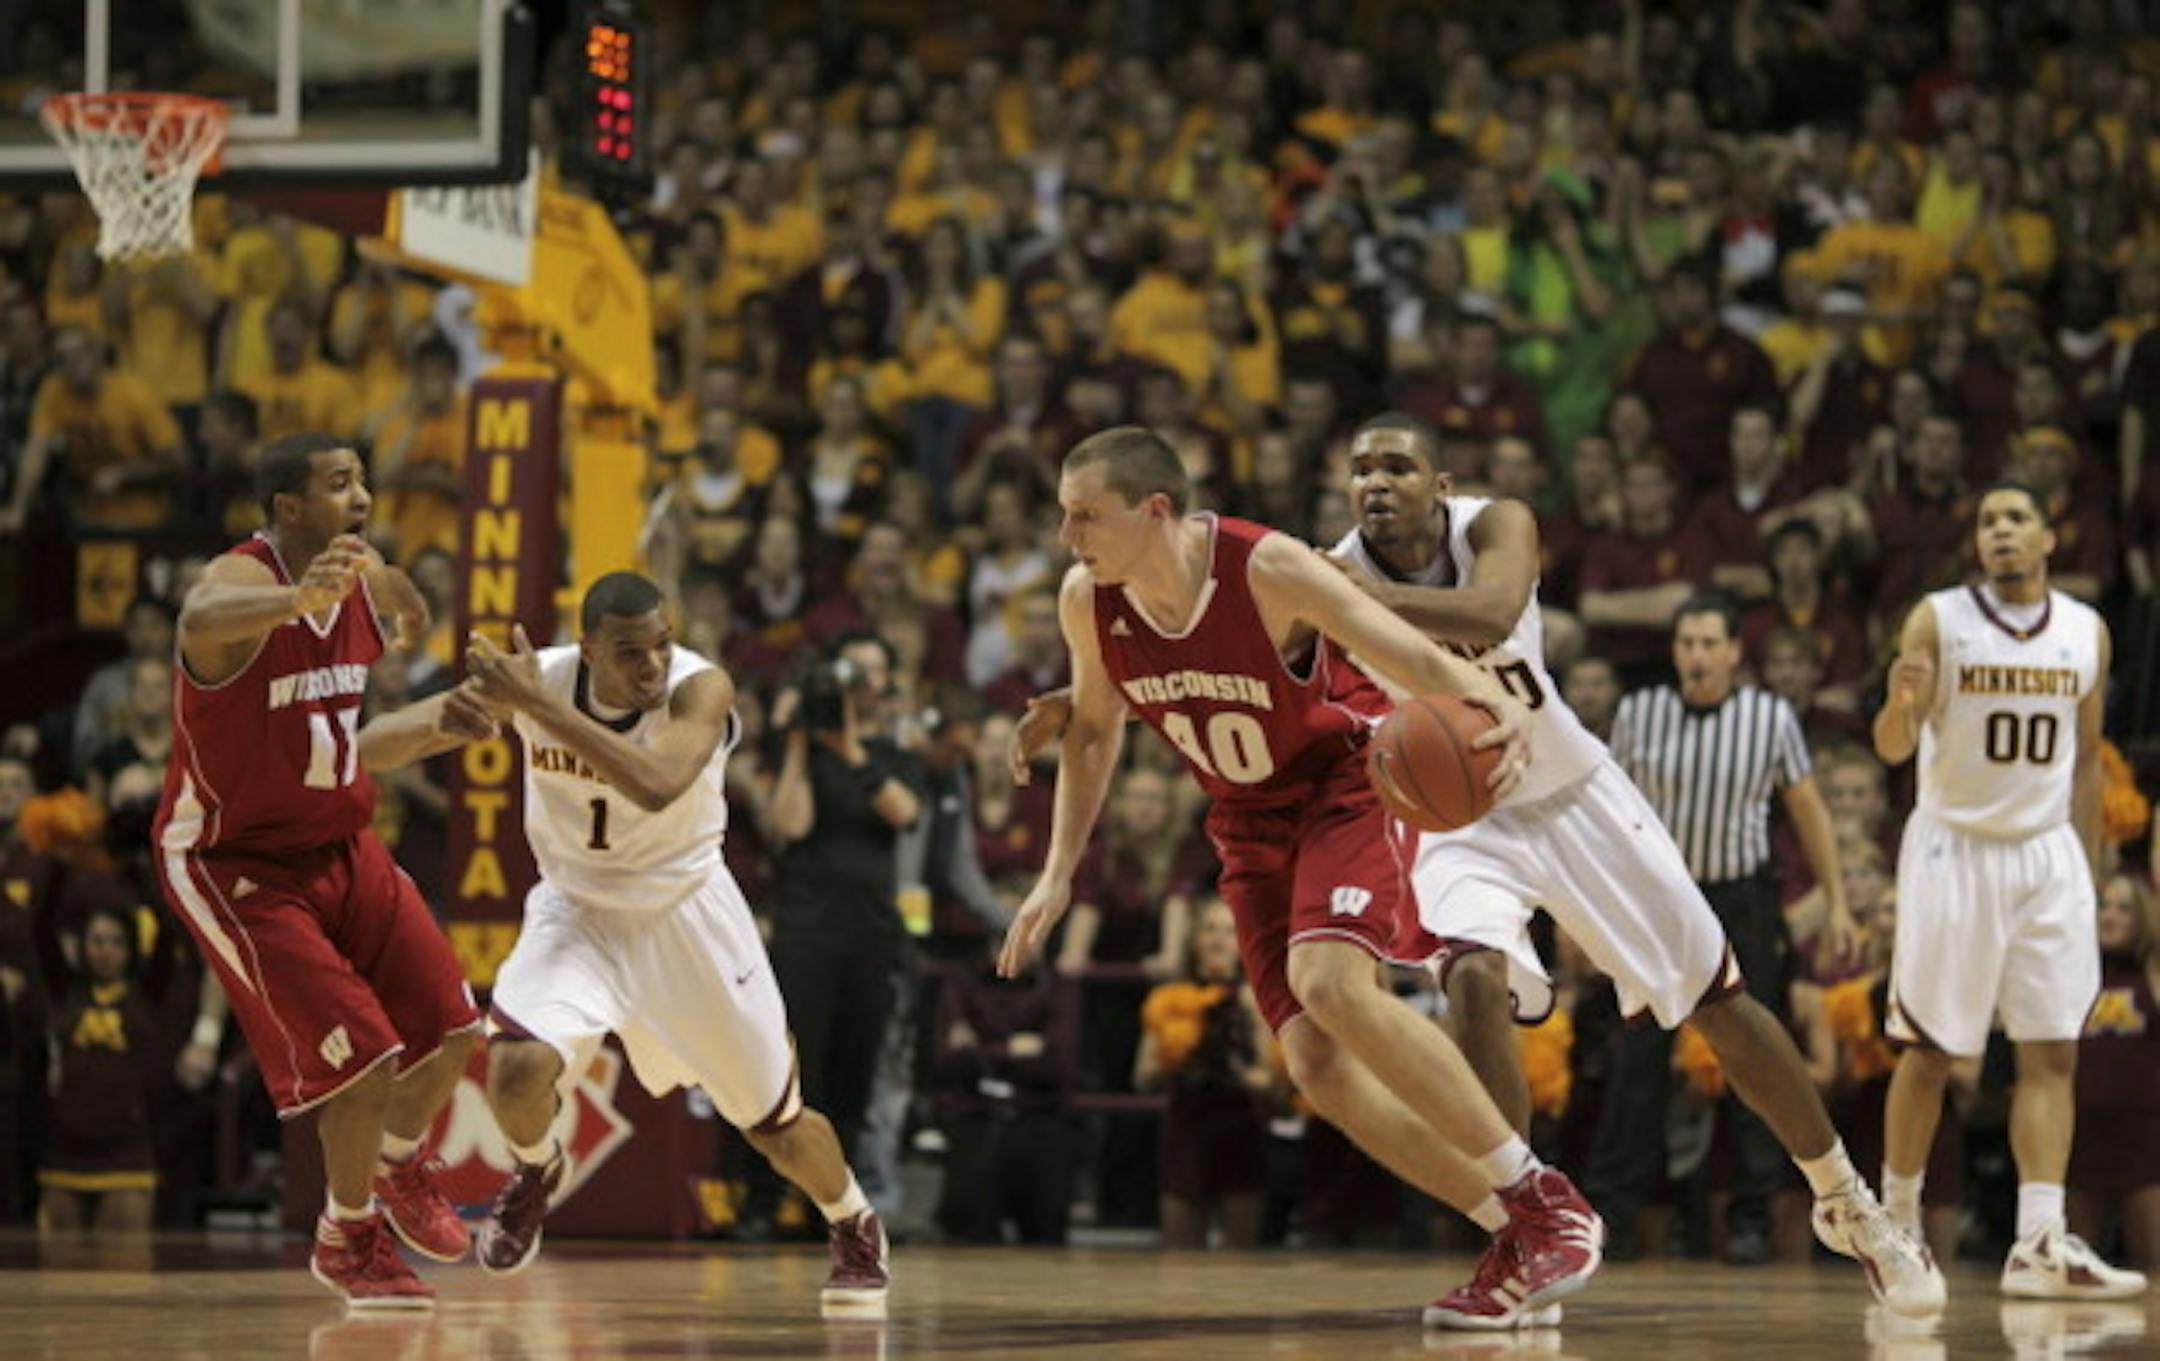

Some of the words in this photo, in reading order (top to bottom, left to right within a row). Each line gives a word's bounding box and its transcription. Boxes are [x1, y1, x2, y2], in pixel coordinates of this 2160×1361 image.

[460, 400, 532, 898] MINNOTA
[1120, 670, 1274, 711] WISCONSIN
[1986, 711, 2058, 765] 00
[588, 797, 610, 849] 1
